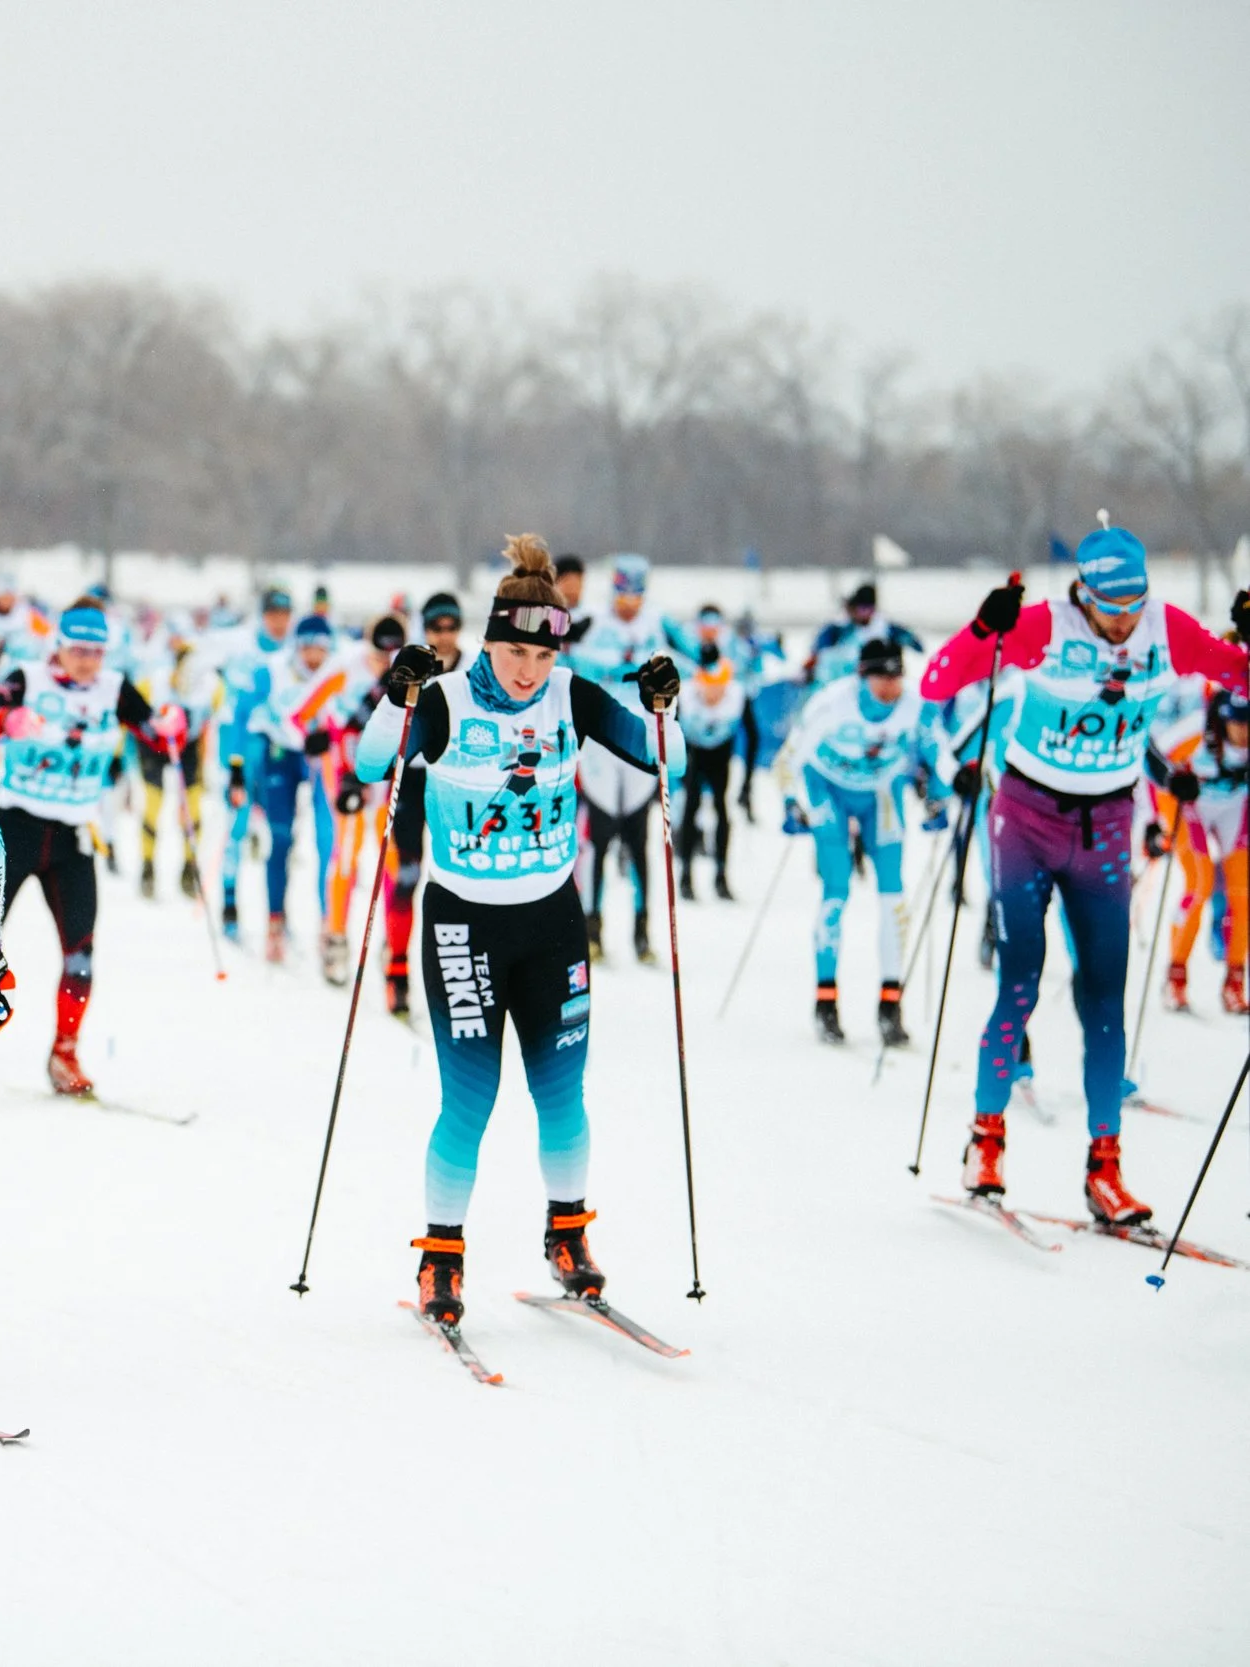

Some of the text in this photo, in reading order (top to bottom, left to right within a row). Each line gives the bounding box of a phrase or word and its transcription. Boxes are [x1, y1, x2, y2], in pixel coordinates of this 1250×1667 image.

[466, 796, 563, 832] 1333
[448, 841, 569, 871] LOPPET
[434, 923, 487, 1039] BIRKIE
[473, 952, 495, 1007] TEAM
